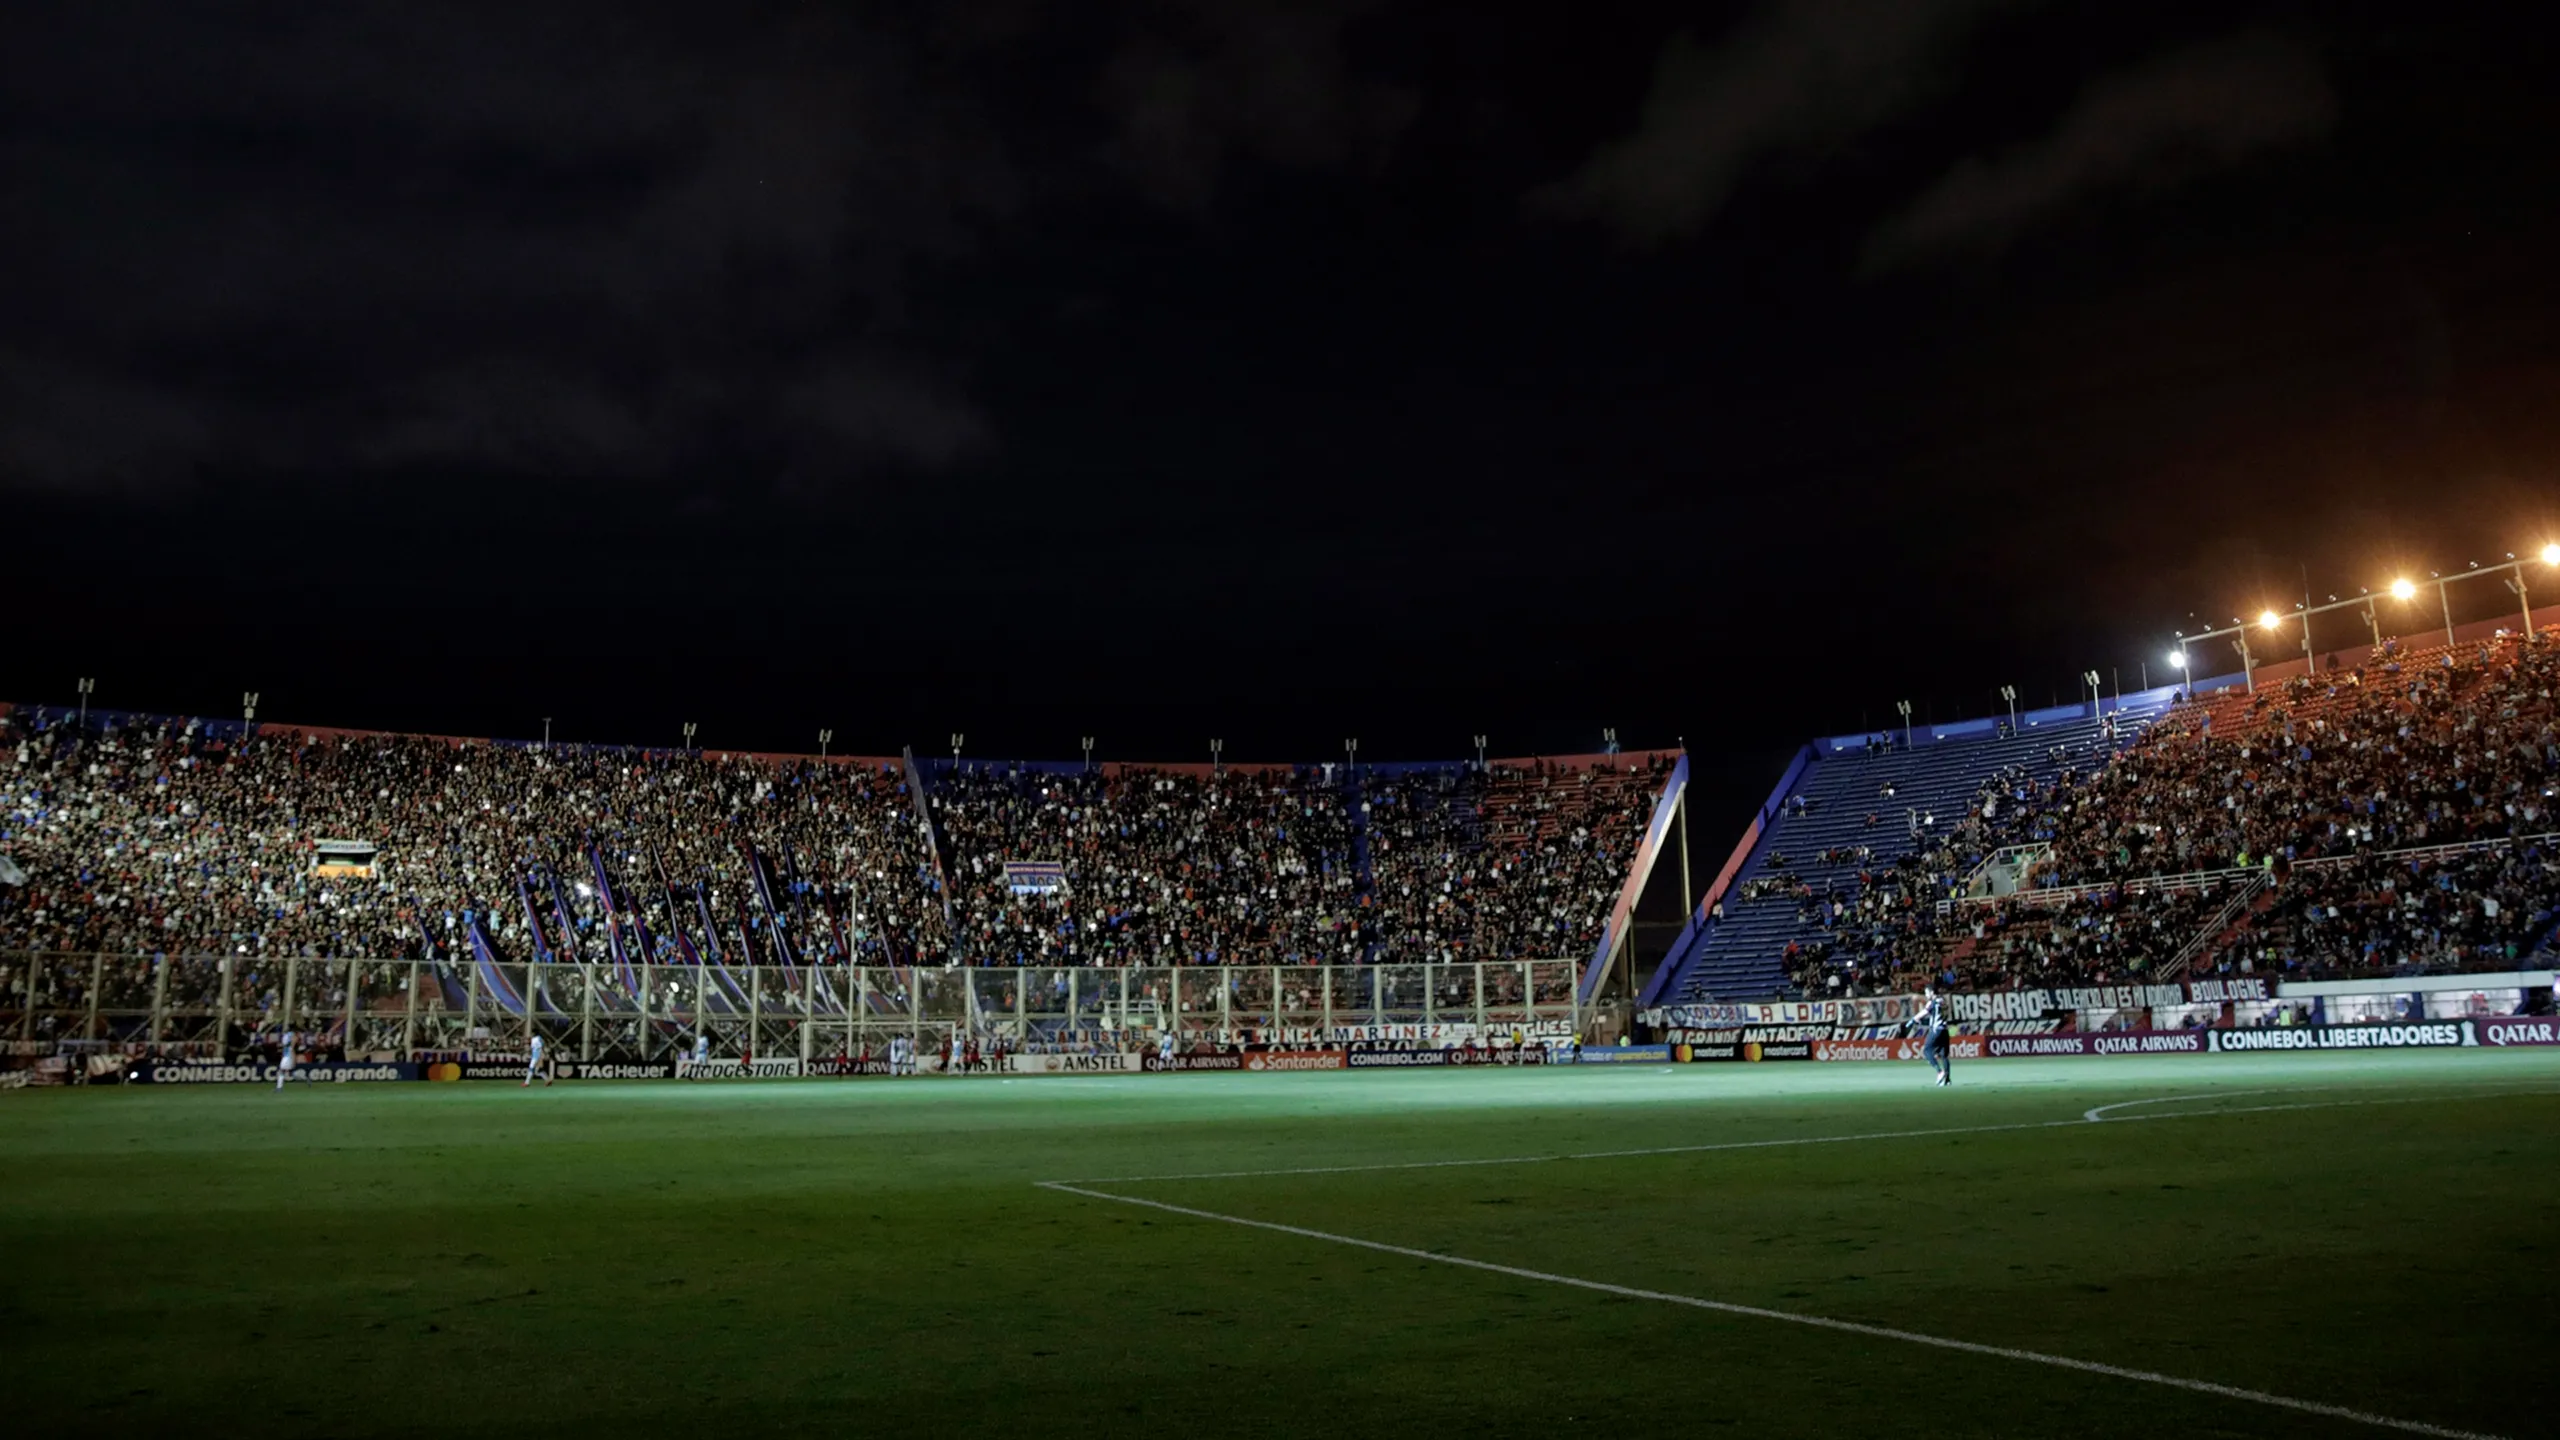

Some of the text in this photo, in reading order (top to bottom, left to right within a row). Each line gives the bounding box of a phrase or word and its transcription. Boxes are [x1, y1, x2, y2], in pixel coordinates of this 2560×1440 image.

[2192, 979, 2266, 1002] BOULOGNE
[1744, 1002, 1836, 1022] LA LOMA
[1953, 991, 2042, 1019] ROSARIO
[1046, 1030, 1129, 1043] SAN JUSTO
[1256, 1027, 1321, 1043] TUNEL
[2222, 1024, 2459, 1050] CONMEBOL LIBERTADORES
[2487, 1023, 2554, 1046] QATAR
[1764, 1046, 1808, 1056] mastercard
[1829, 1043, 1888, 1061] Santander
[1989, 1038, 2084, 1055] QATAR AIRWAYS
[2094, 1035, 2199, 1055] QATAR AIRWAYS
[1063, 1055, 1128, 1071] AMSTEL
[1189, 1056, 1240, 1069] AIRWAYS
[1267, 1054, 1342, 1069] Santander
[1350, 1052, 1444, 1066] CONMEBOL.COM
[152, 1067, 262, 1082] CONMEBOL
[309, 1069, 332, 1081] en
[466, 1066, 542, 1078] masterca
